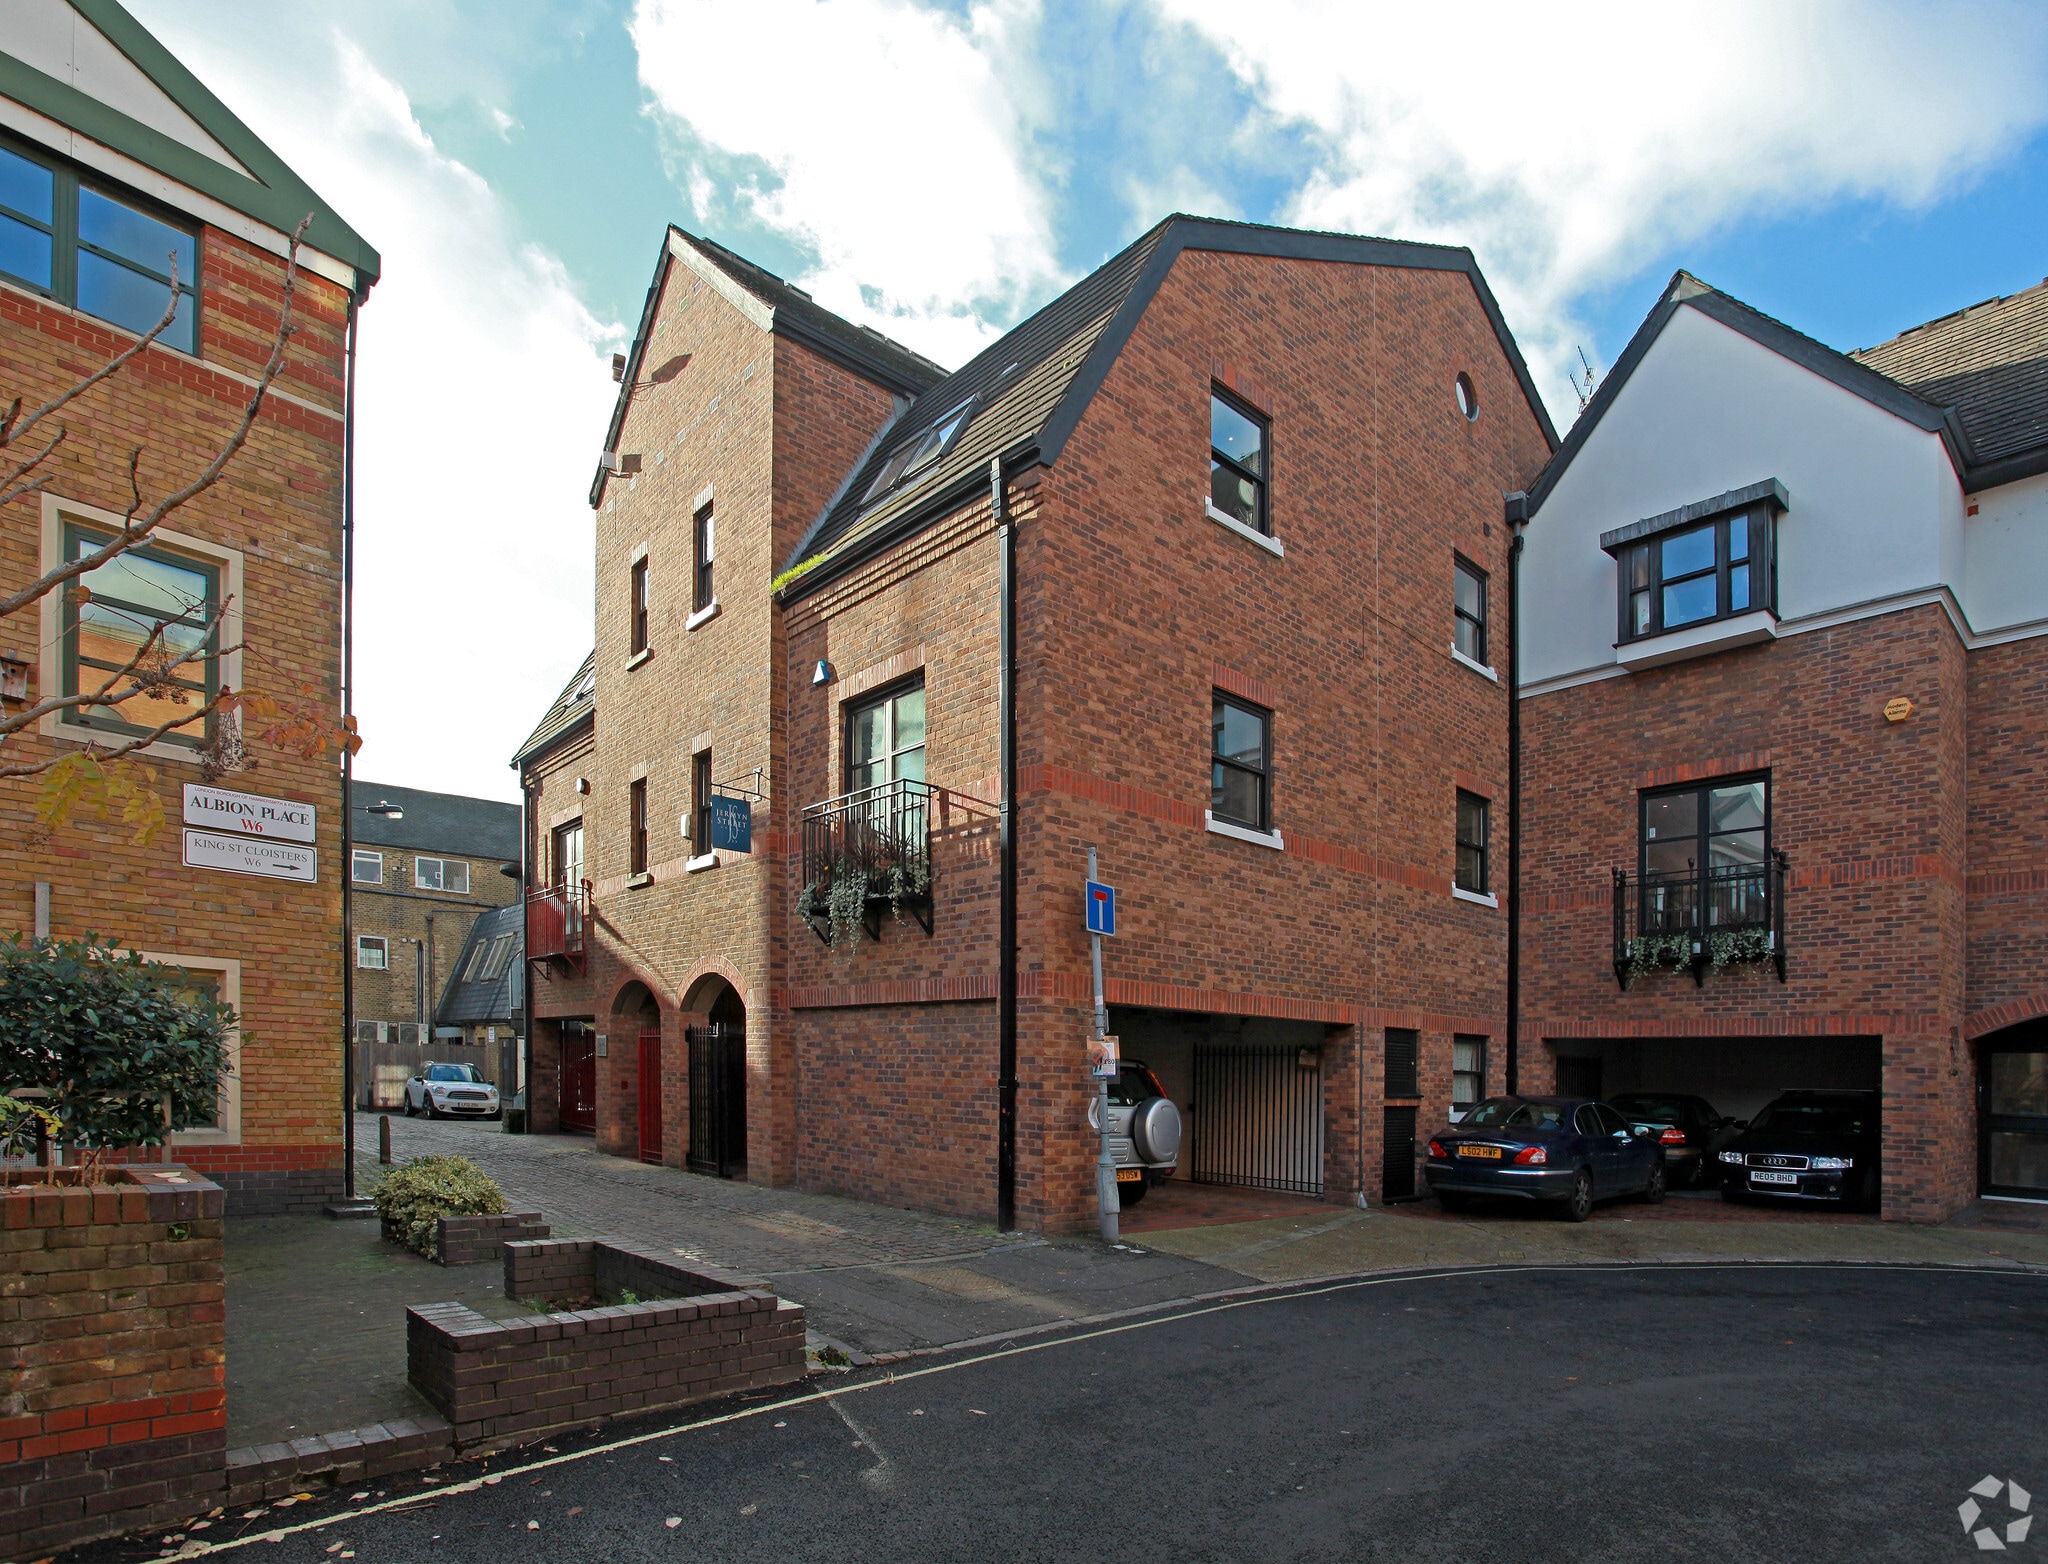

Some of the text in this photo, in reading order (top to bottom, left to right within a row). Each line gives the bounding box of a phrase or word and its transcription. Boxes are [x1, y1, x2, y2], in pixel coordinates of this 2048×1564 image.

[194, 787, 215, 795] LONDON
[249, 797, 283, 805] HAMMERSMITH
[190, 795, 310, 825] ALBION PLACE
[716, 808, 747, 820] JERMYN
[241, 818, 263, 833] W6
[717, 817, 746, 828] STREET
[194, 838, 308, 863] KING ST CLOISTERS
[244, 857, 262, 867] W6
[1461, 1147, 1498, 1157] LS02 HWF
[1754, 1172, 1775, 1181] RE05
